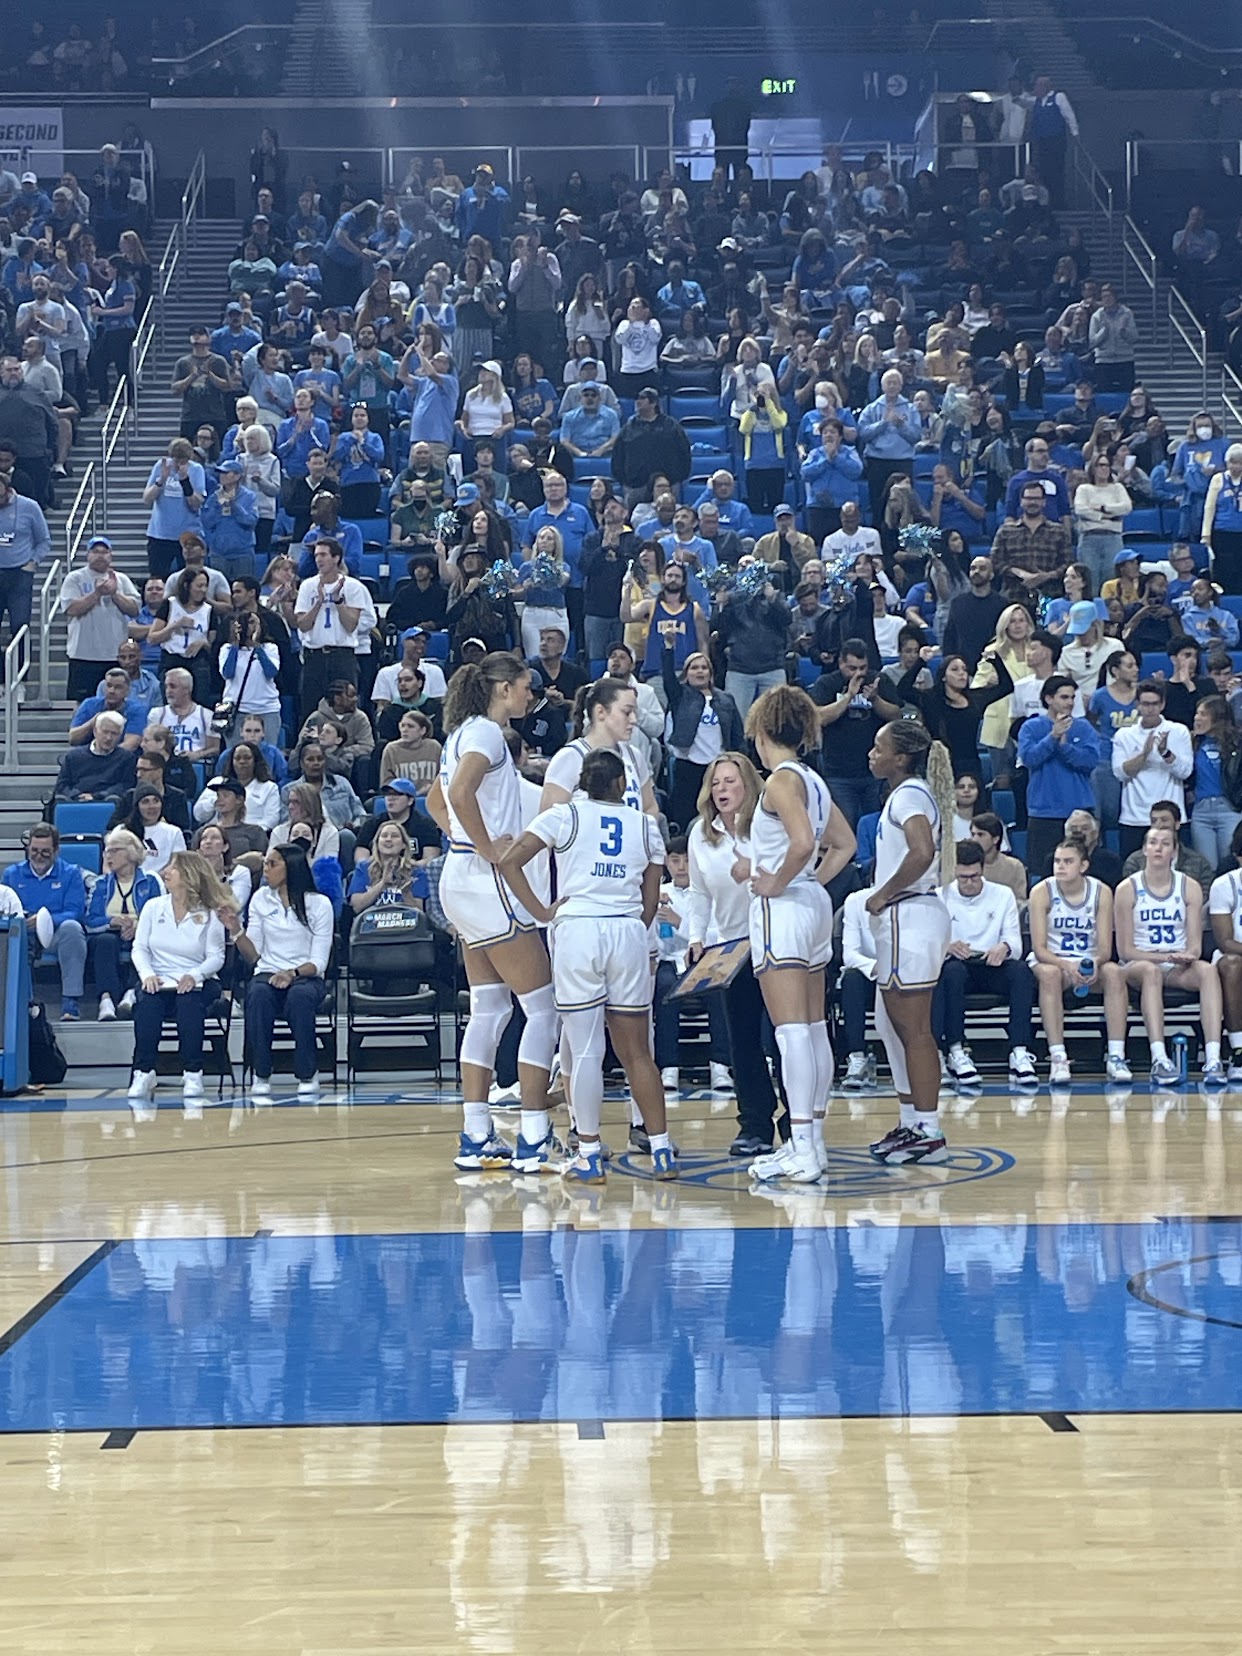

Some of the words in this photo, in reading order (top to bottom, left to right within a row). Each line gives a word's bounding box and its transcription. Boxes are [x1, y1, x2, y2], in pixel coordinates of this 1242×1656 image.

[762, 79, 796, 94] EXIT
[324, 607, 332, 628] 1
[600, 815, 623, 857] 3
[591, 862, 627, 879] JONES
[373, 912, 403, 922] MARCH
[1140, 908, 1183, 921] UCLA
[1054, 917, 1093, 930] UCLA
[1060, 931, 1089, 951] 23
[1148, 925, 1176, 944] 33
